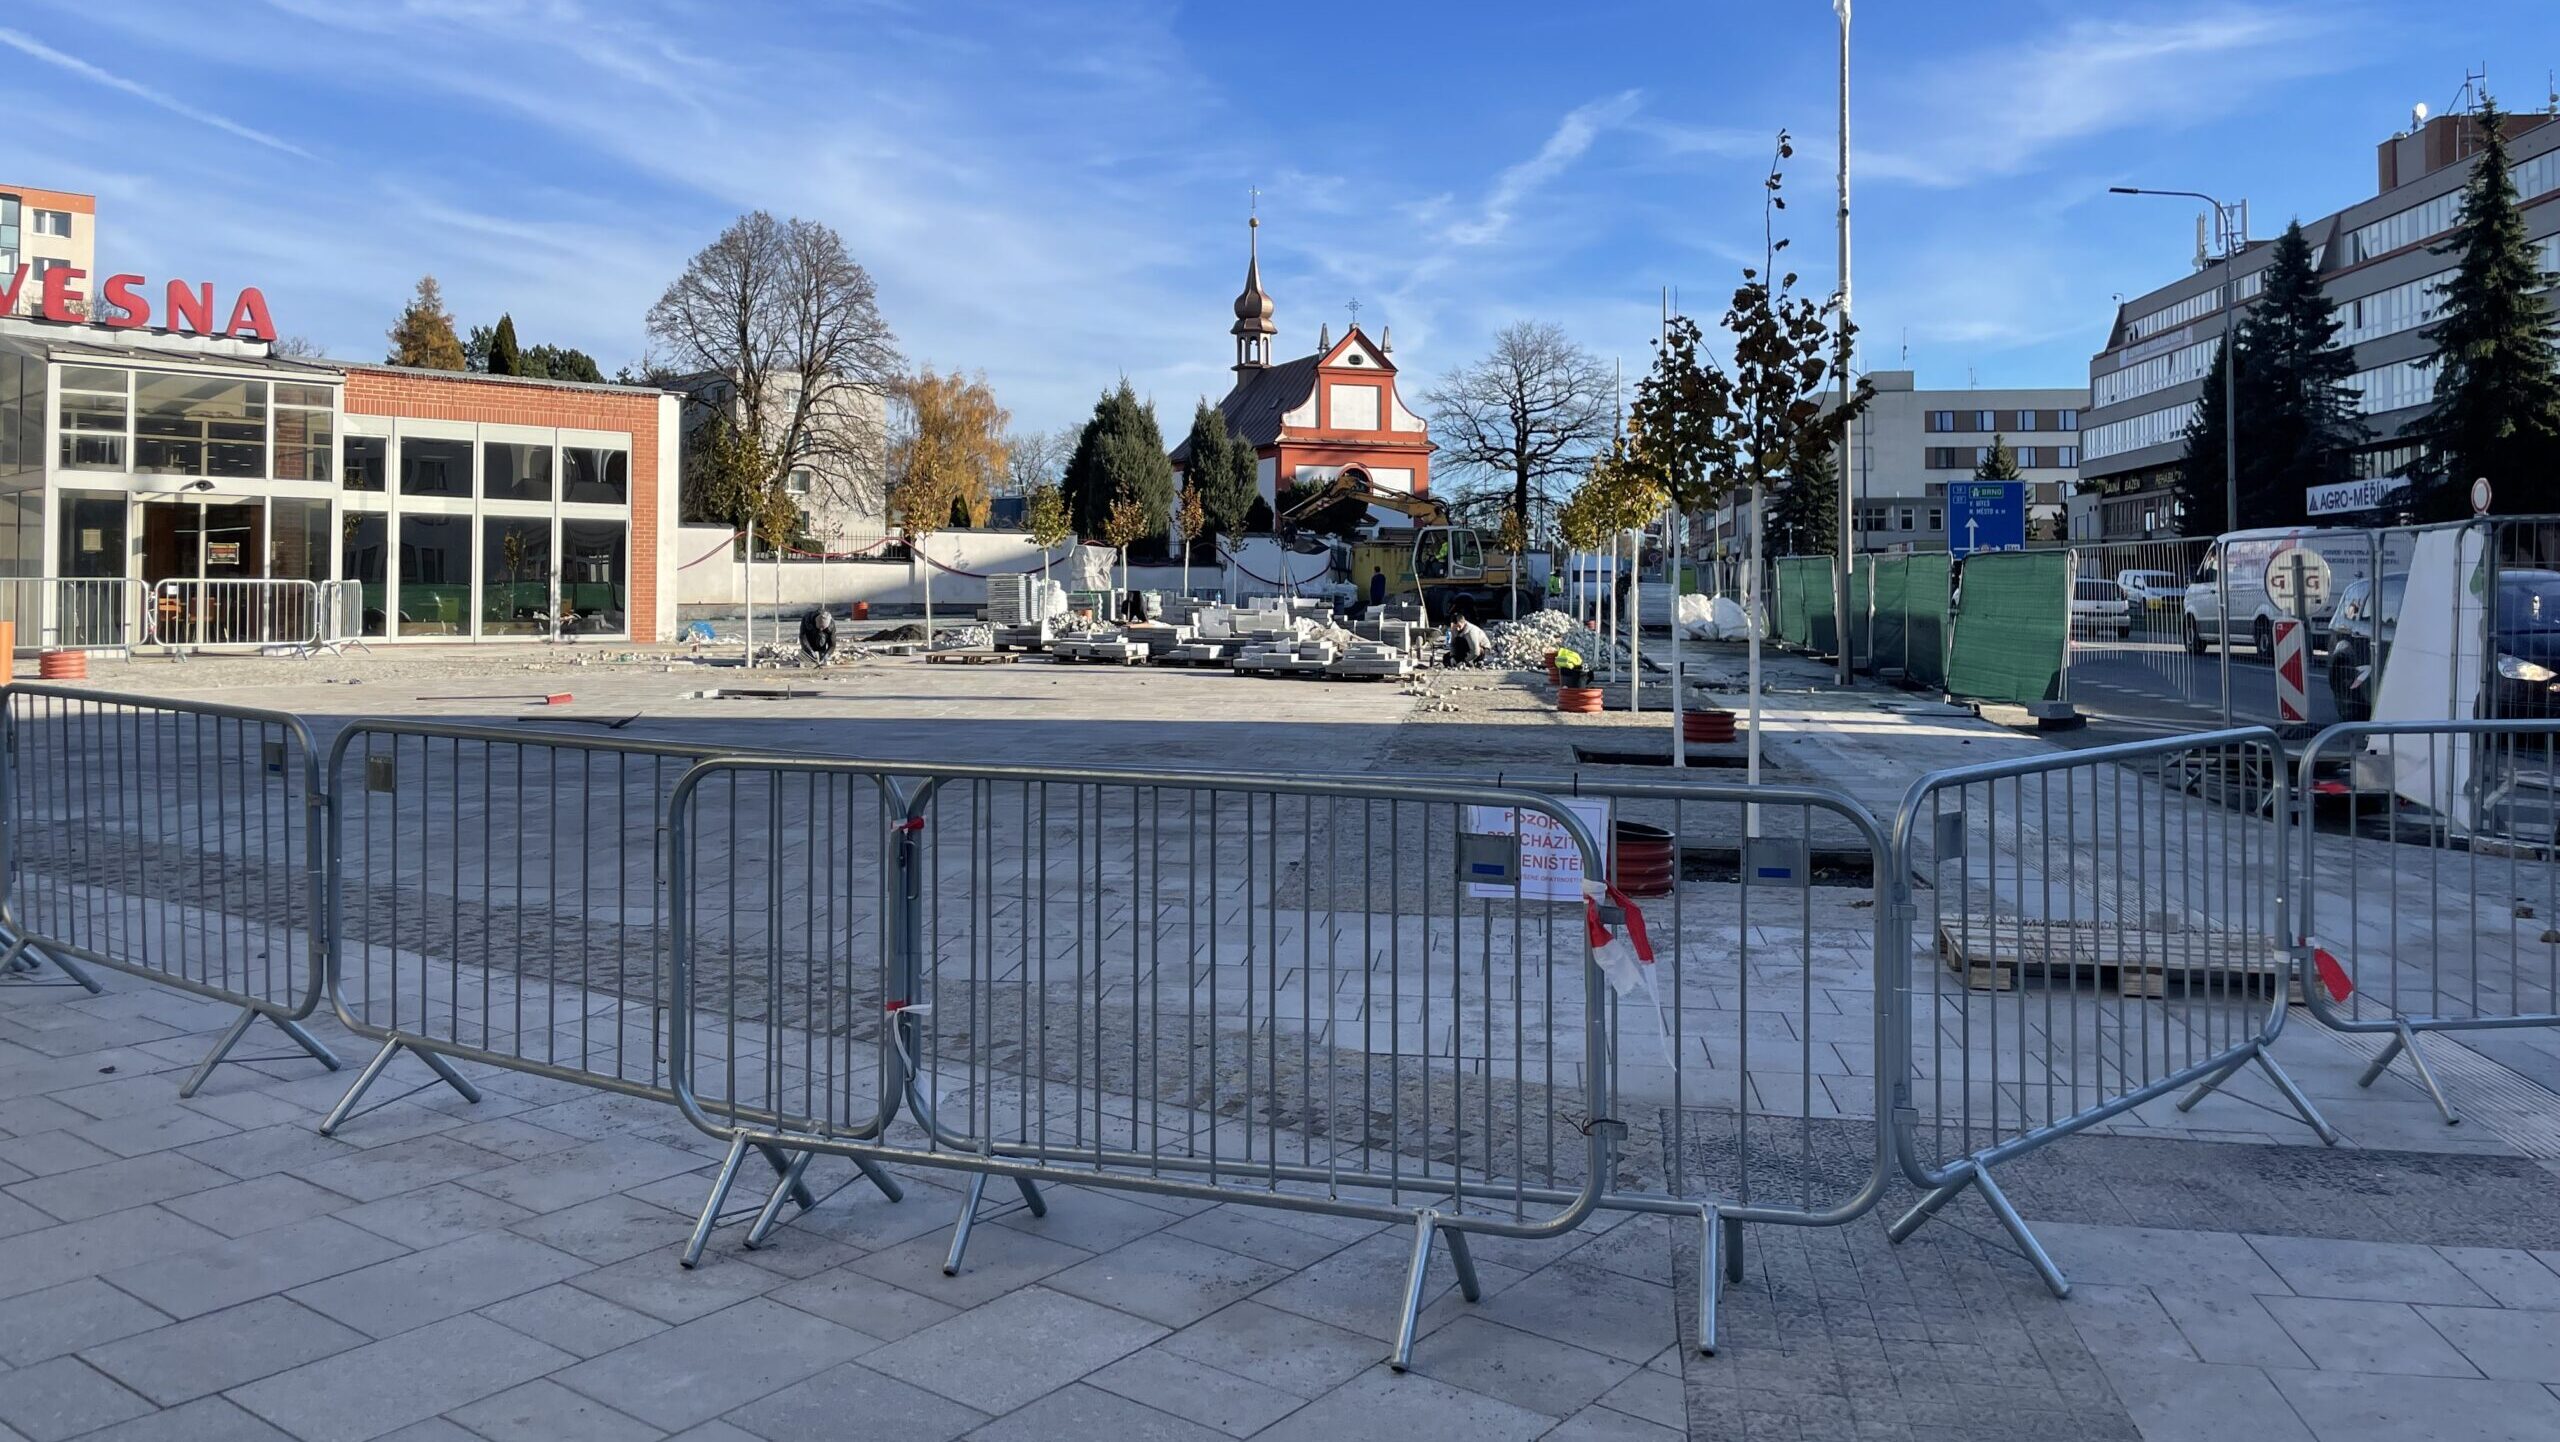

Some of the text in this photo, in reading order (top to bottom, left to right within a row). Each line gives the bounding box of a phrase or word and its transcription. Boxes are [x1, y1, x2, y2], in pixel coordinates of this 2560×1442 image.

[1981, 488, 2002, 496] BRNO
[2320, 481, 2389, 510] AGRO-MĚŘÍN
[1504, 811, 1560, 830] POZOR
[1521, 853, 1584, 871] ENIŠTĚ
